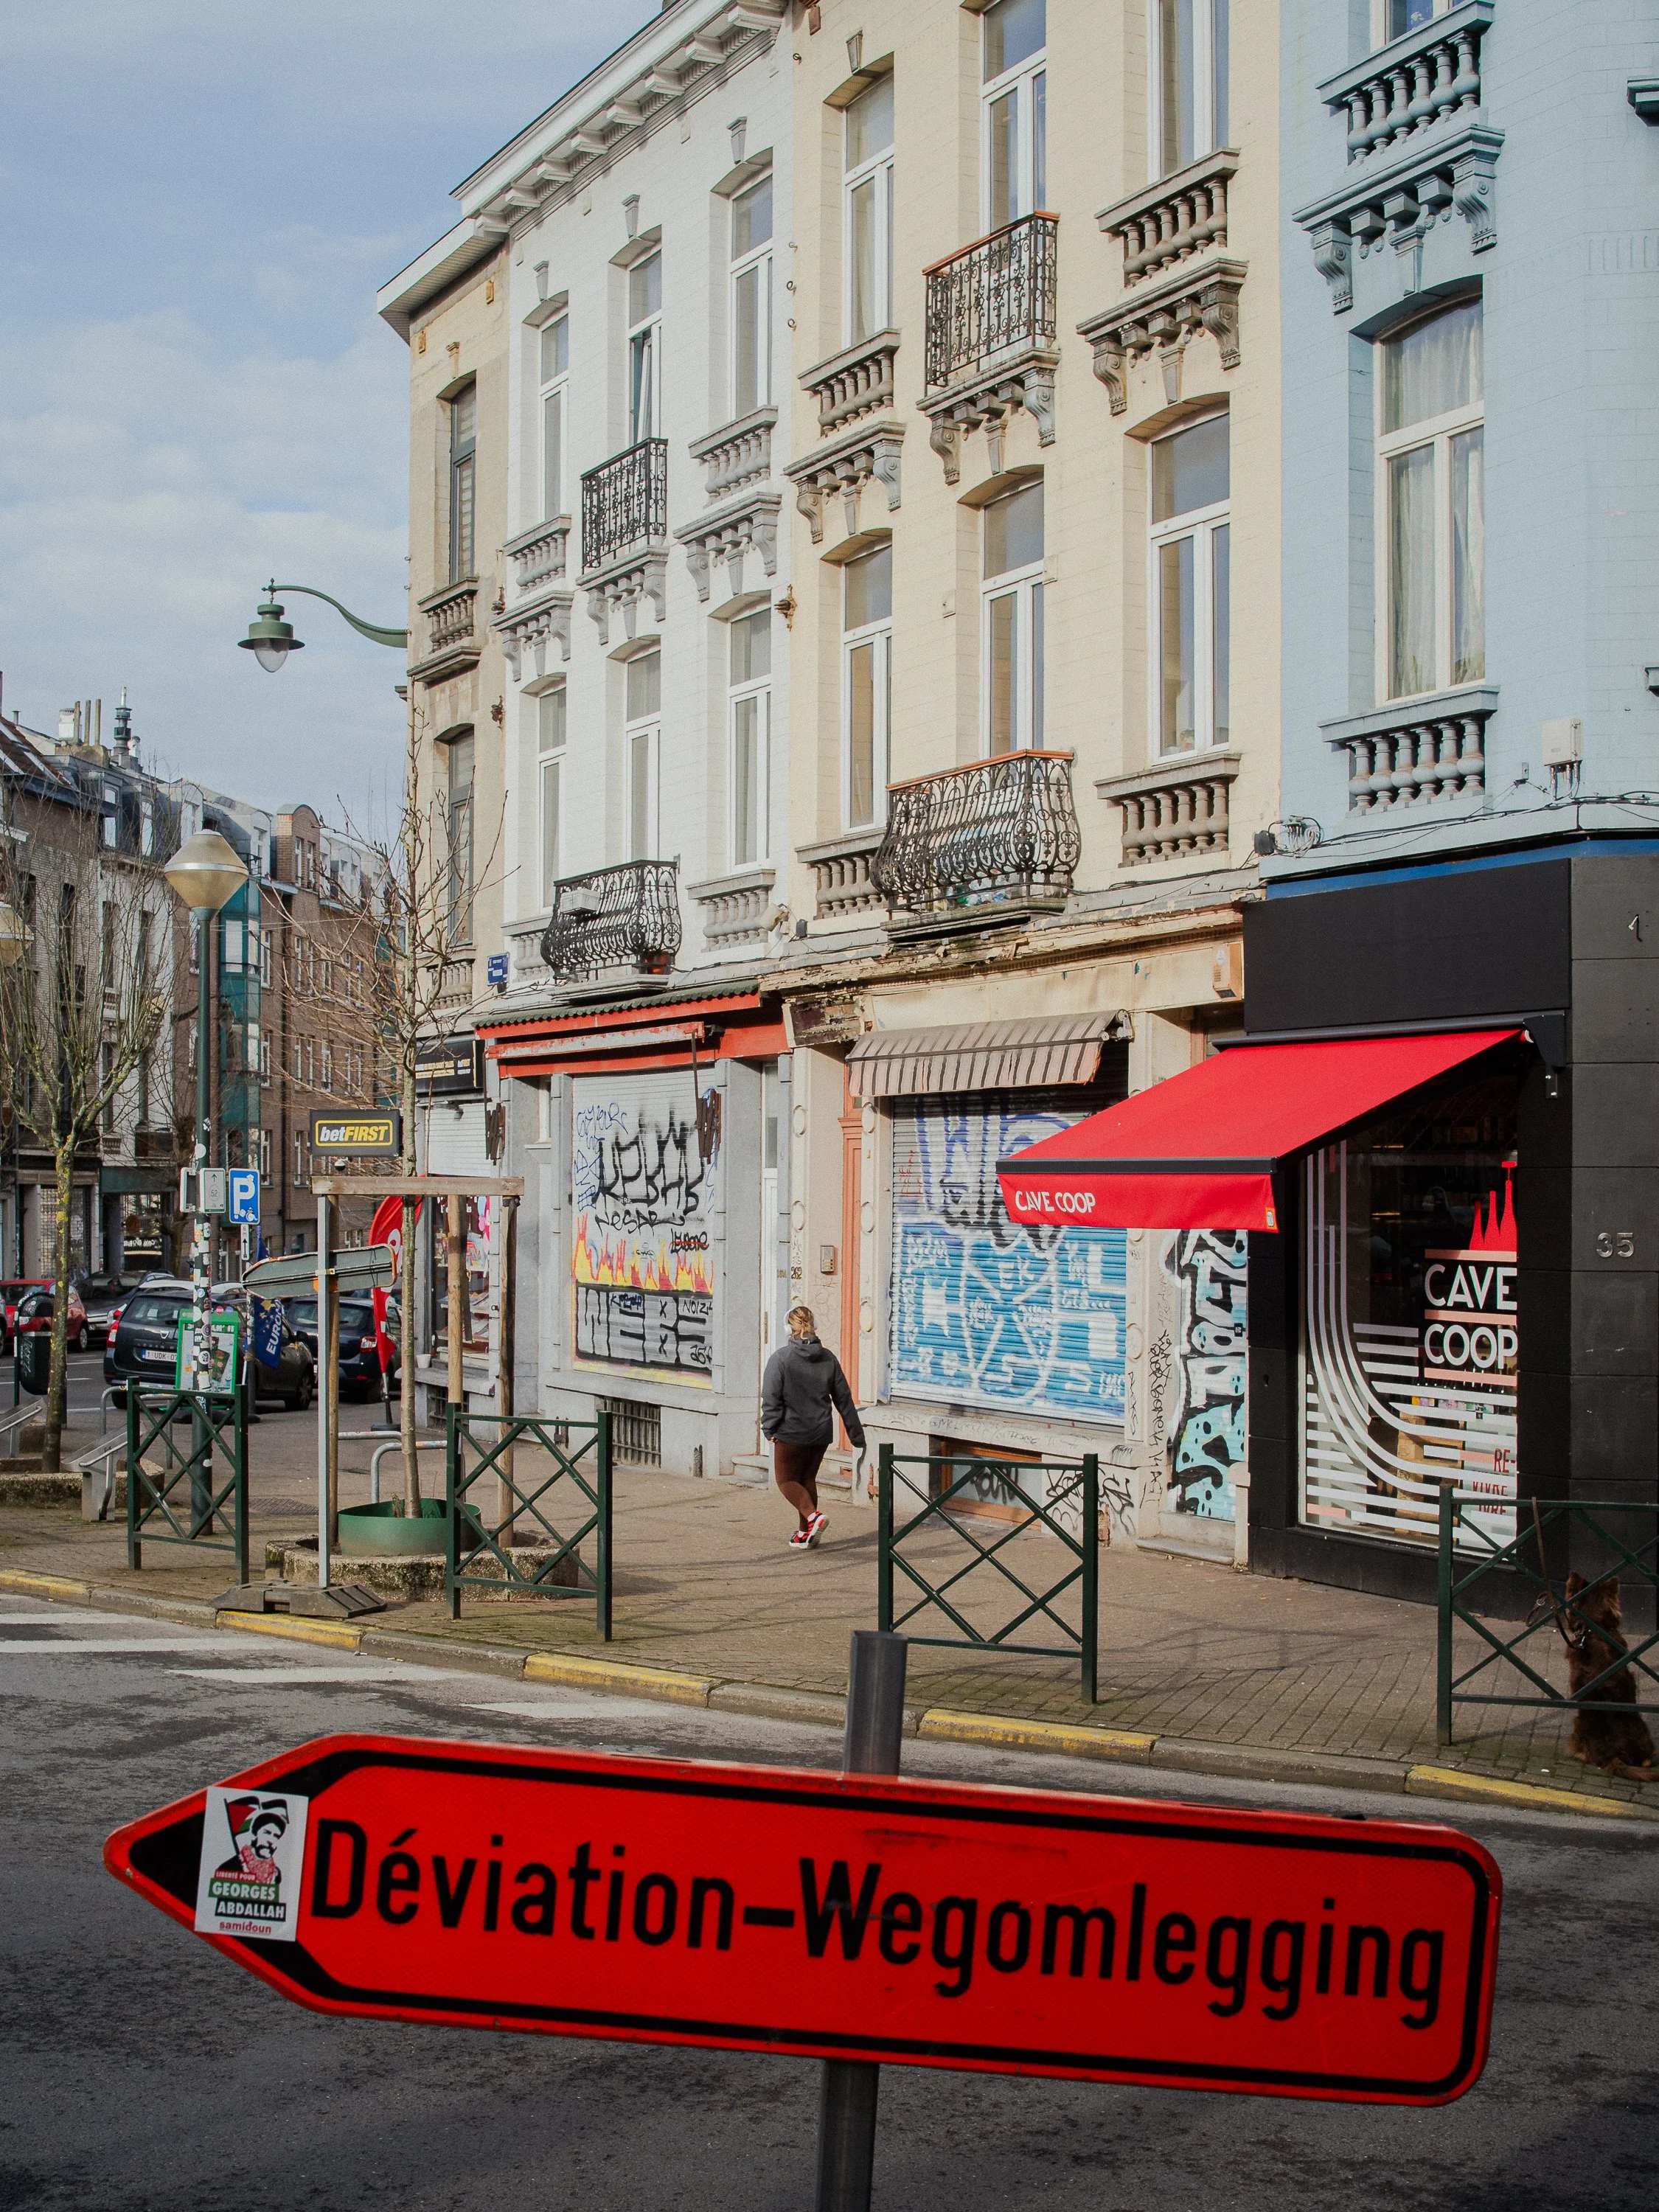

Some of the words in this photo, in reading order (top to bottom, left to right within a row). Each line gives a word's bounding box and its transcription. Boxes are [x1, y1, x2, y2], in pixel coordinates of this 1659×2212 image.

[319, 1126, 389, 1142] betFIRST
[233, 1177, 256, 1215] P
[1015, 1191, 1055, 1211] CAVE
[1054, 1192, 1096, 1214] COOP
[1596, 1232, 1635, 1259] 35
[1425, 1264, 1517, 1310] CAVE
[1425, 1324, 1518, 1369] COOP
[215, 1870, 238, 1879] LIBERTÉ
[239, 1873, 256, 1881] POUR
[213, 1882, 276, 1899] GEORGES
[217, 1902, 285, 1919] ABDALLAH
[219, 1921, 271, 1933] samidoun
